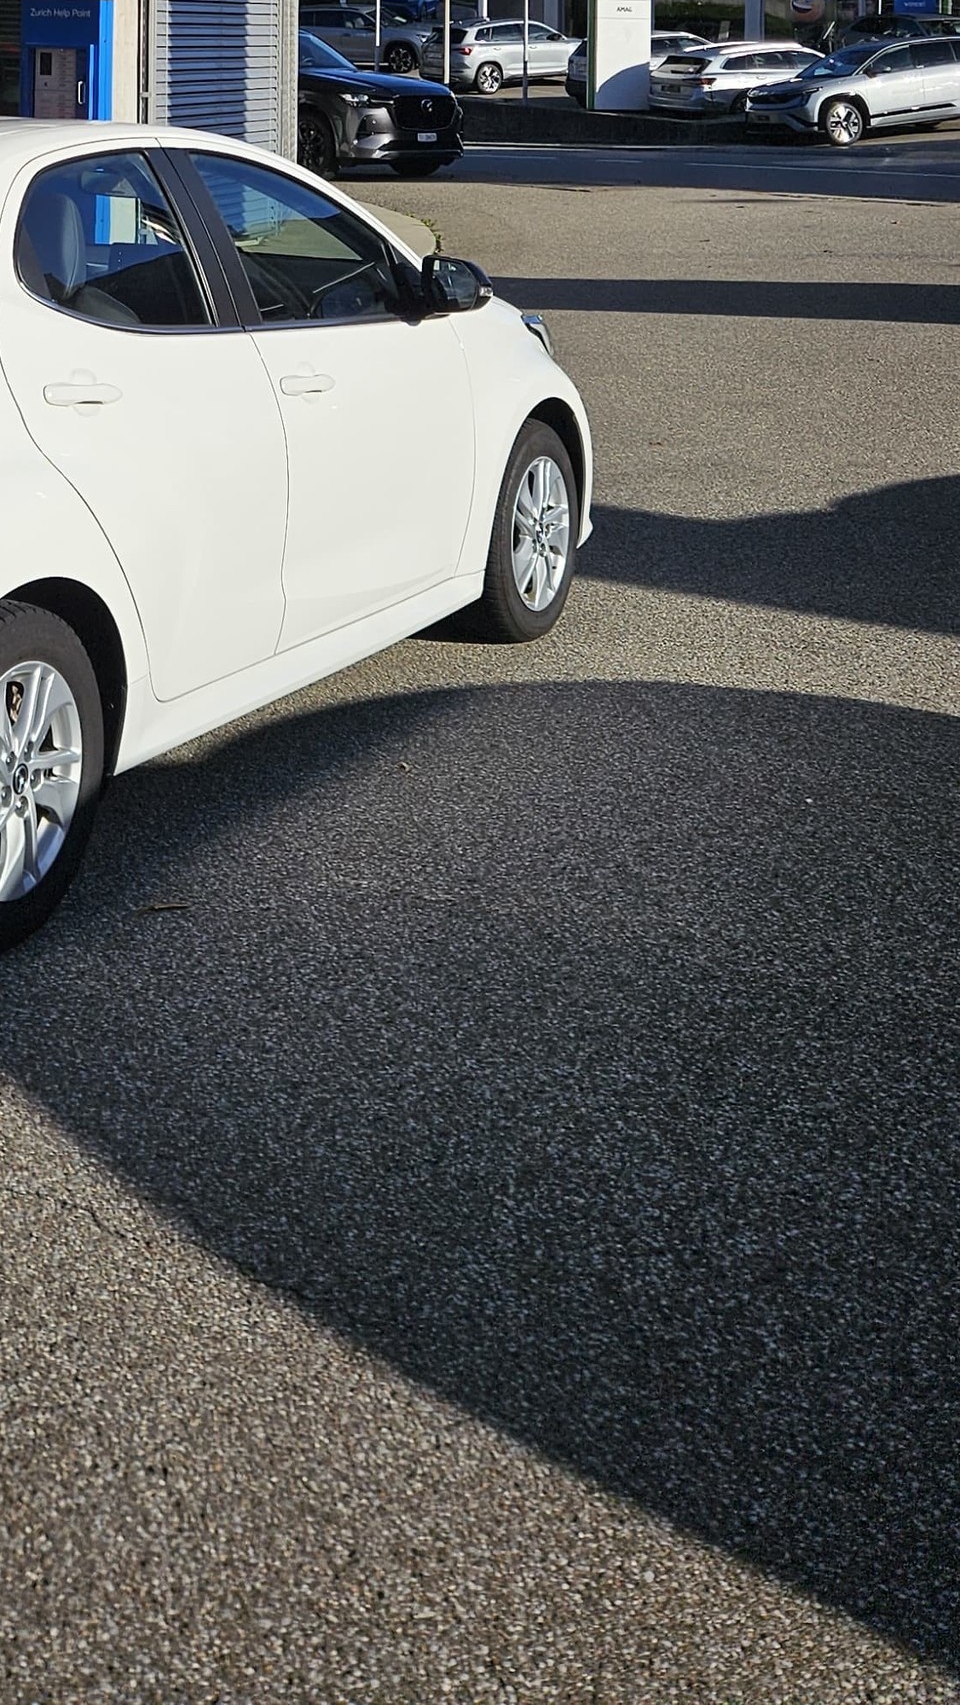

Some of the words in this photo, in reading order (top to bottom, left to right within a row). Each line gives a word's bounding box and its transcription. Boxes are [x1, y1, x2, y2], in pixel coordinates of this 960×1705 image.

[30, 8, 52, 17] Zurich
[53, 8, 71, 18] Help
[71, 8, 91, 18] Point
